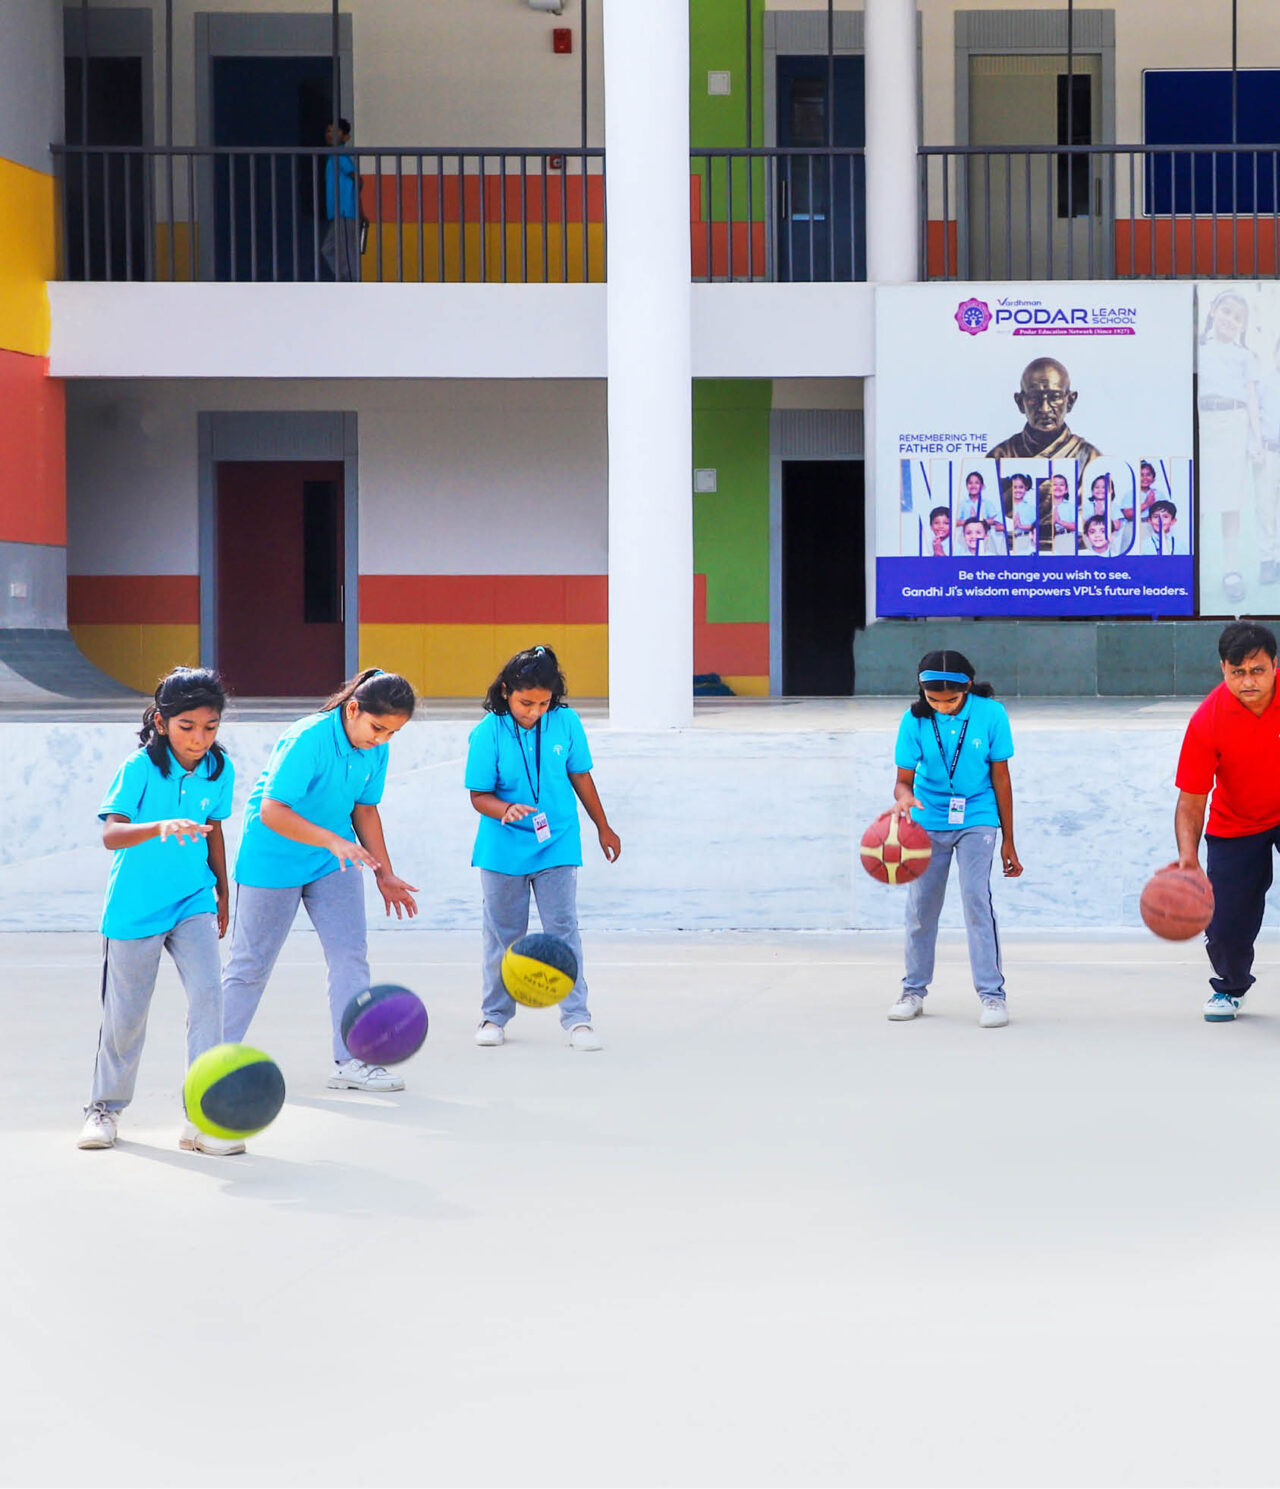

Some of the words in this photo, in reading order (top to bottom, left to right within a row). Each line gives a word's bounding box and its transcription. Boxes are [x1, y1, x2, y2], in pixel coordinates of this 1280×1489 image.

[998, 297, 1042, 306] Vardhman
[996, 308, 1088, 324] PODAR
[1092, 308, 1136, 316] LEARN
[900, 434, 967, 442] REMEMBERING
[900, 444, 943, 453] FATHER
[946, 444, 962, 452] OF
[965, 443, 988, 452] THE
[901, 457, 1194, 558] NATION
[958, 570, 974, 580] Be
[976, 570, 996, 580] the
[998, 570, 1040, 582] change
[1042, 572, 1063, 582] you
[1066, 570, 1092, 580] wish
[1094, 571, 1106, 580] to
[1108, 572, 1132, 580] see.
[902, 586, 943, 596] Gandhi
[965, 586, 1009, 596] wisdom
[1012, 588, 1071, 598] empowers
[1073, 586, 1102, 596] VPL's
[1104, 586, 1140, 596] future
[1143, 586, 1188, 596] leaders.
